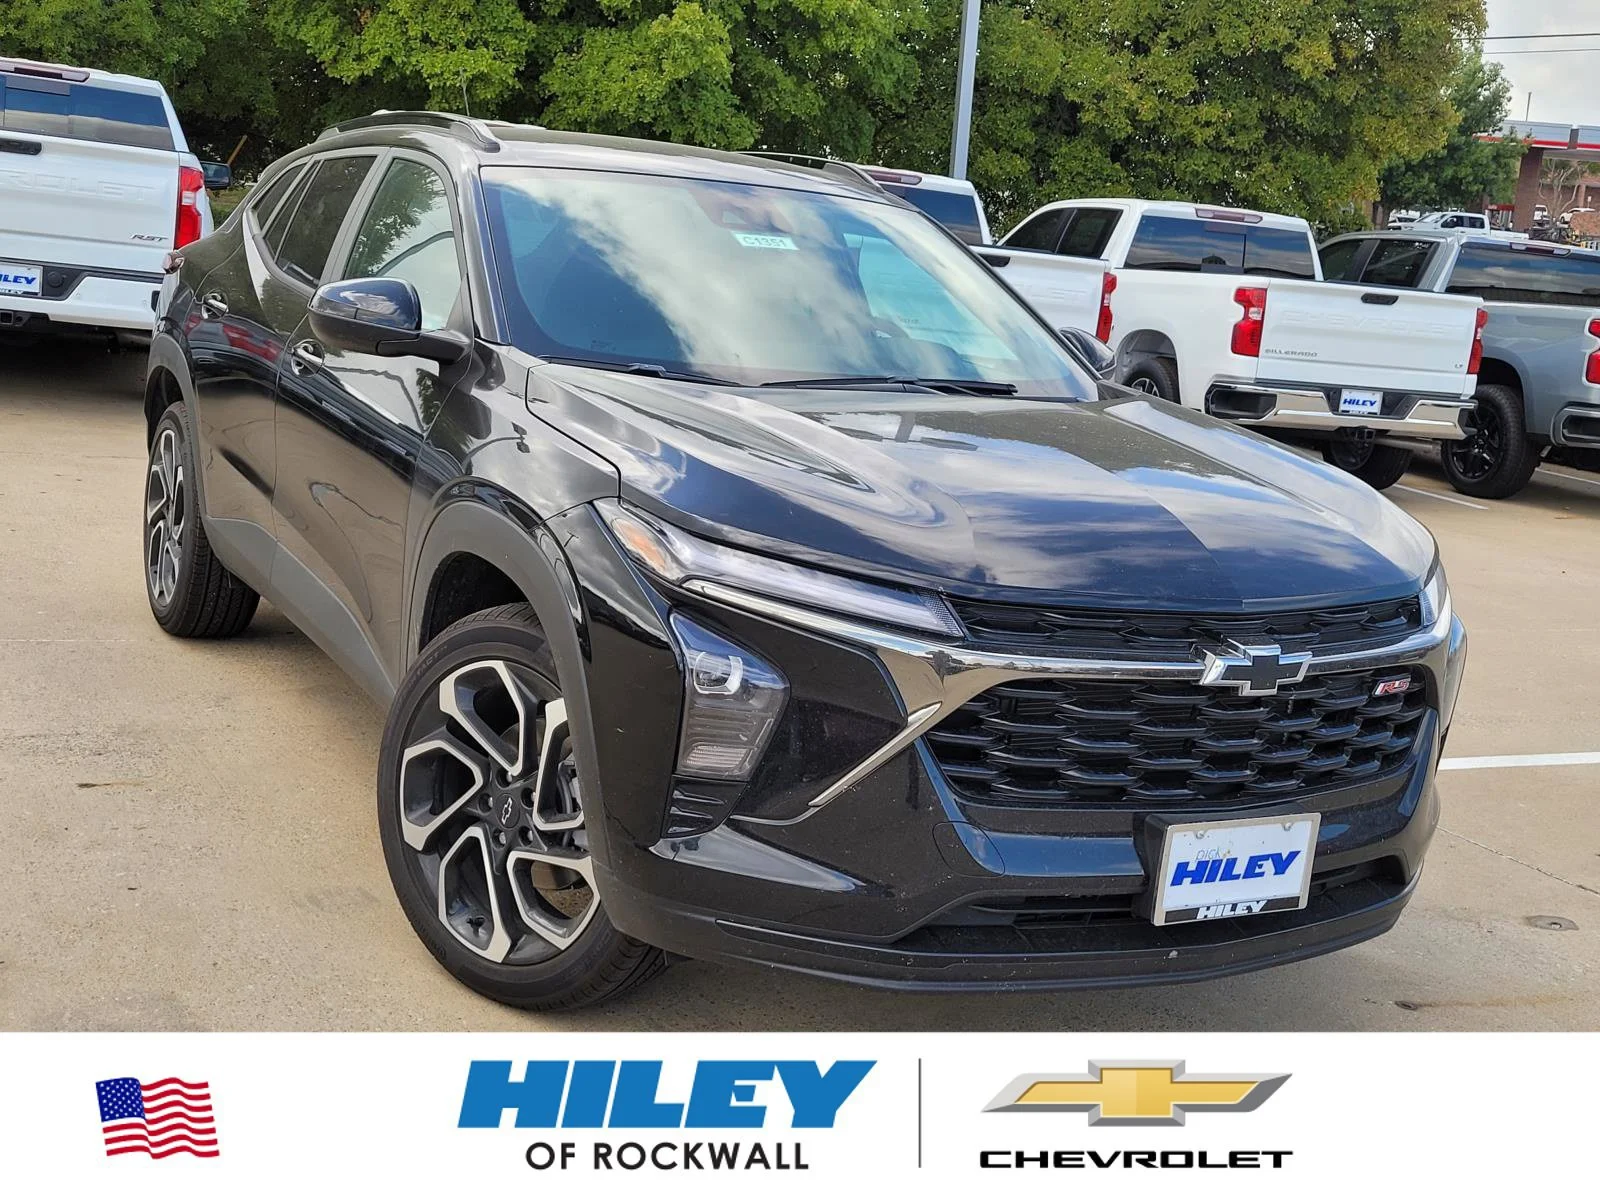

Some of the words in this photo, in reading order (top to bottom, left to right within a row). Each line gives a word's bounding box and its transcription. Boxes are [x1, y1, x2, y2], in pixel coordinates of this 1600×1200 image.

[130, 234, 169, 243] RST
[1342, 398, 1377, 407] HILEY
[1376, 680, 1409, 696] RS
[1170, 850, 1301, 887] HILEY
[1196, 900, 1268, 920] HILEY
